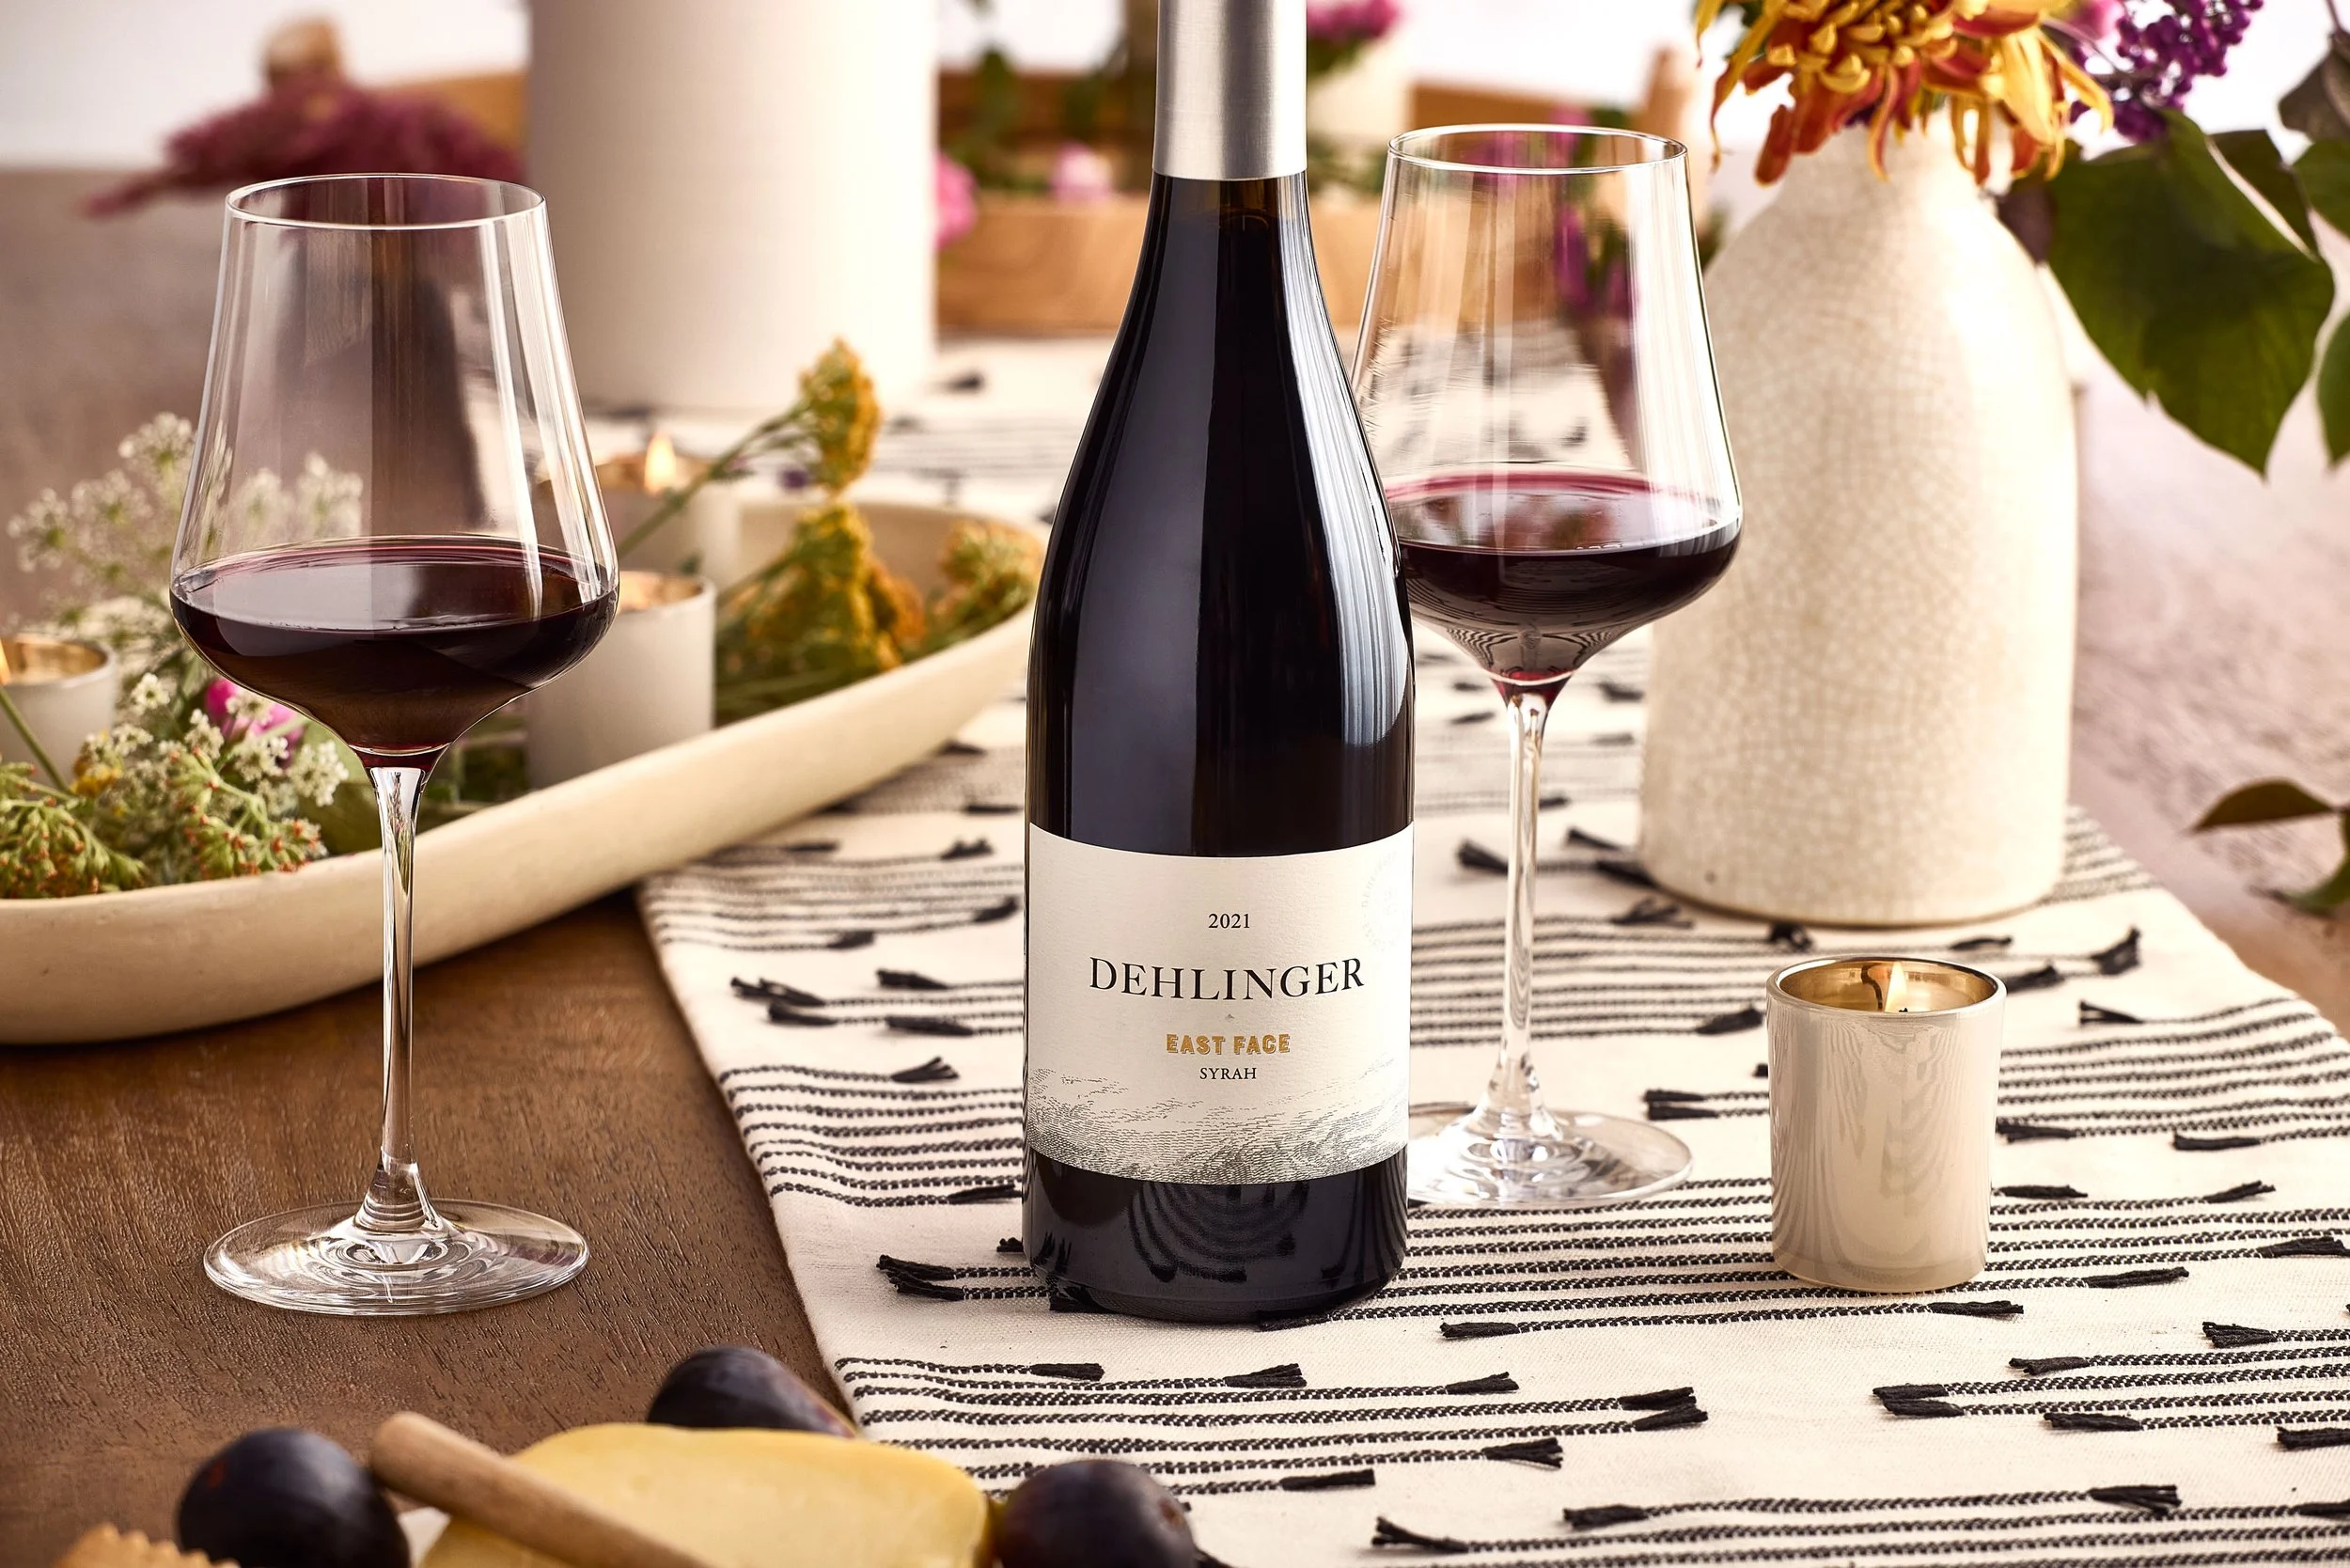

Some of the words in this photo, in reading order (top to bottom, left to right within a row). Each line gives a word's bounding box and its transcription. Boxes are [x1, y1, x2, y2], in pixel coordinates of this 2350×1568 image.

[1208, 913, 1250, 930] 2021
[1089, 957, 1365, 1001] DEHLINGER
[1166, 1033, 1226, 1056] EAST
[1233, 1033, 1291, 1056] FACE
[1199, 1067, 1257, 1080] SYRAH
